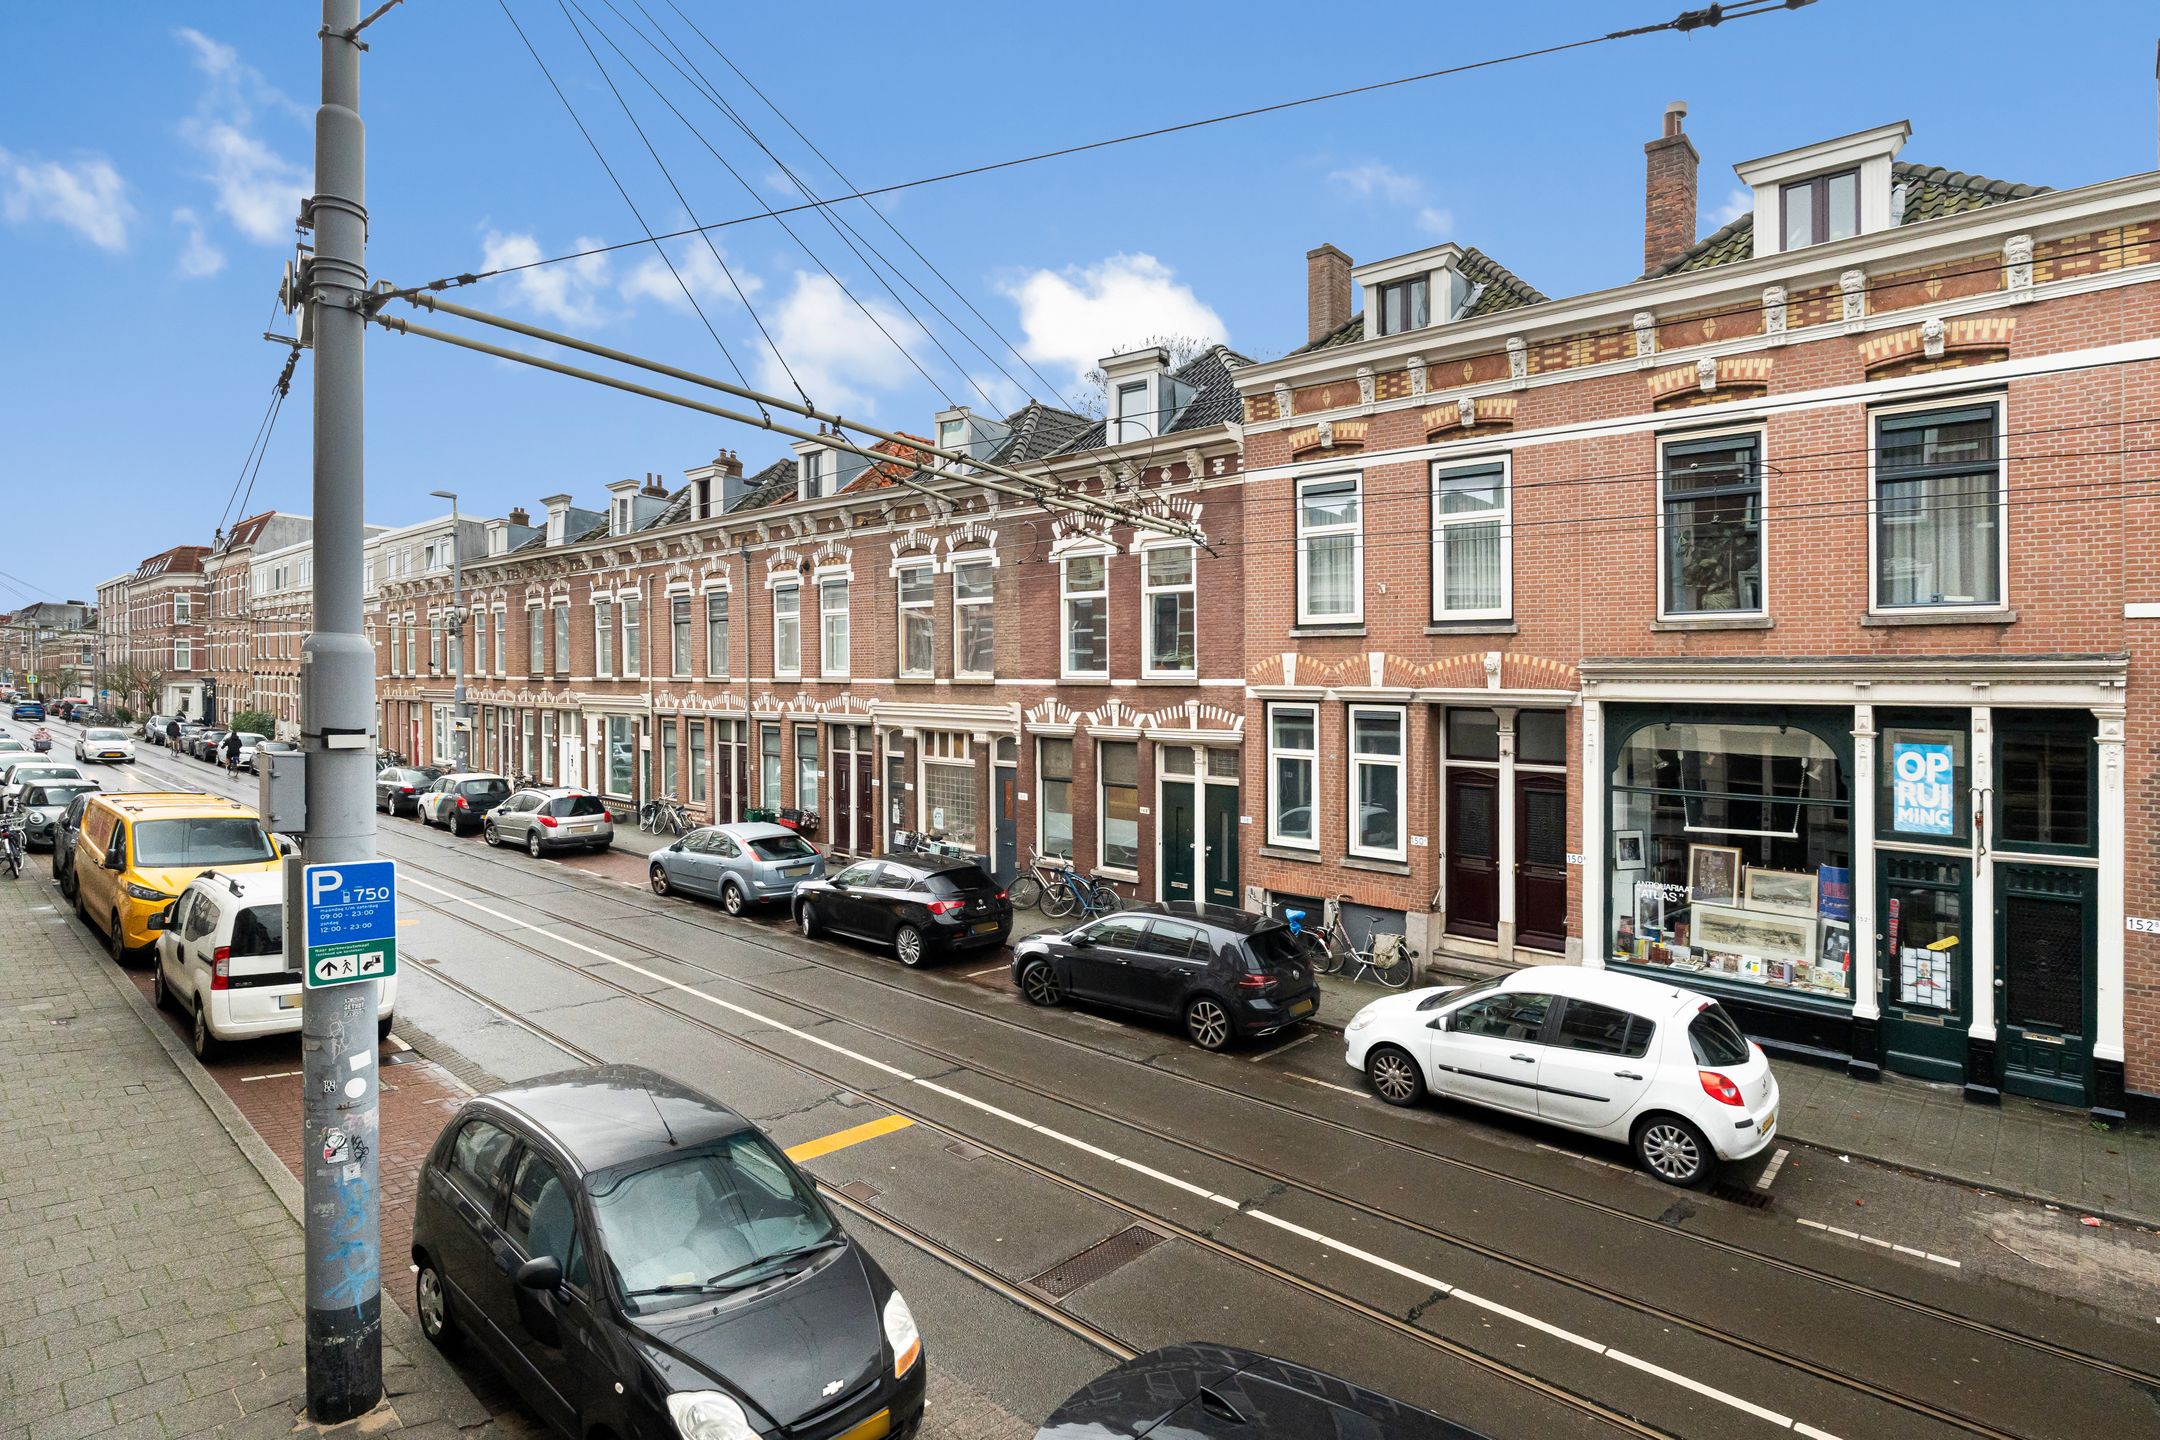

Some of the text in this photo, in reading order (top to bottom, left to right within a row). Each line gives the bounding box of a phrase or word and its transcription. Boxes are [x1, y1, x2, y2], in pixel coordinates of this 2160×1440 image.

[1896, 751, 1950, 783] OP
[1897, 781, 1949, 809] RUI
[1897, 807, 1950, 826] MING
[312, 870, 389, 905] P 750
[1635, 880, 1694, 893] ANTIQUARIAAT
[320, 912, 343, 920] 09:00
[351, 909, 374, 917] 23:00
[320, 925, 342, 933] 12:00
[349, 922, 373, 930] 23:00
